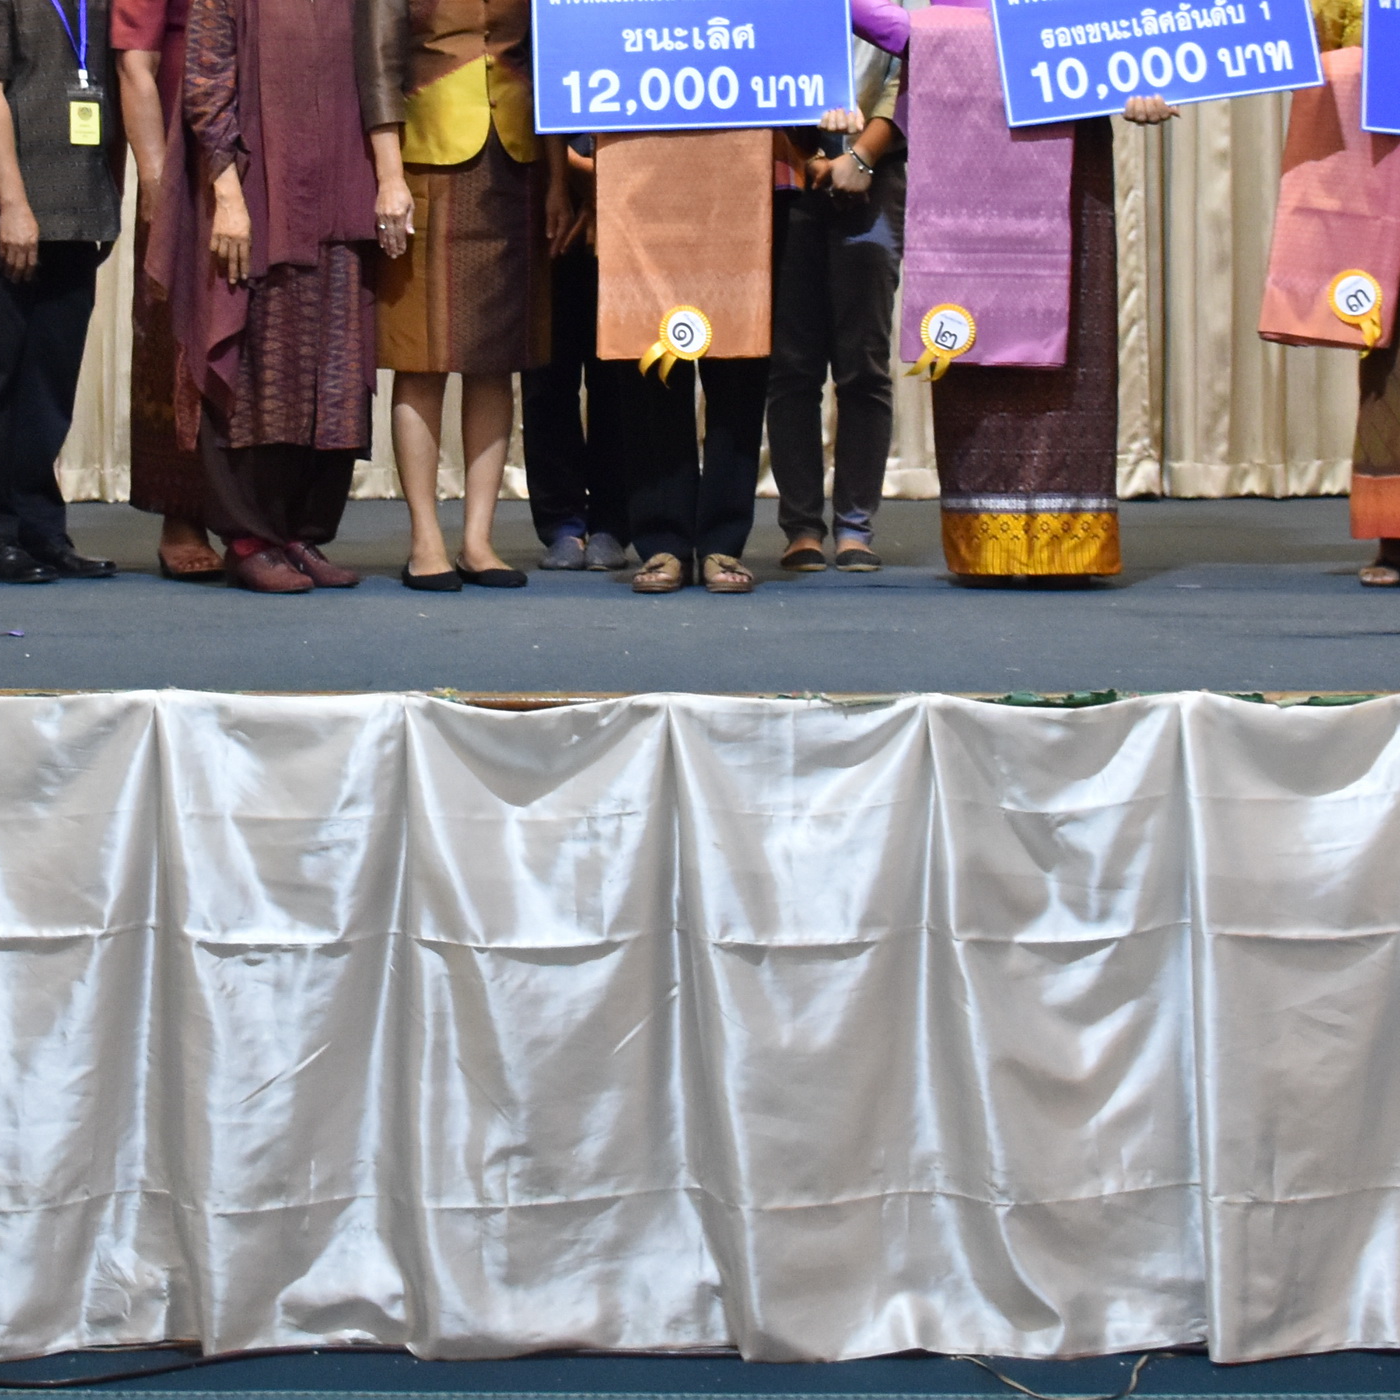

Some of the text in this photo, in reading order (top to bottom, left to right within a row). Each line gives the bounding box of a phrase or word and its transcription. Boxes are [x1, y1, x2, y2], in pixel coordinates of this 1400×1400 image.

[1259, 0, 1271, 20] 1
[621, 16, 755, 53] ชนะเลิศ
[562, 65, 825, 116] 12,000 บาท
[1030, 39, 1294, 102] 10,000 บาท
